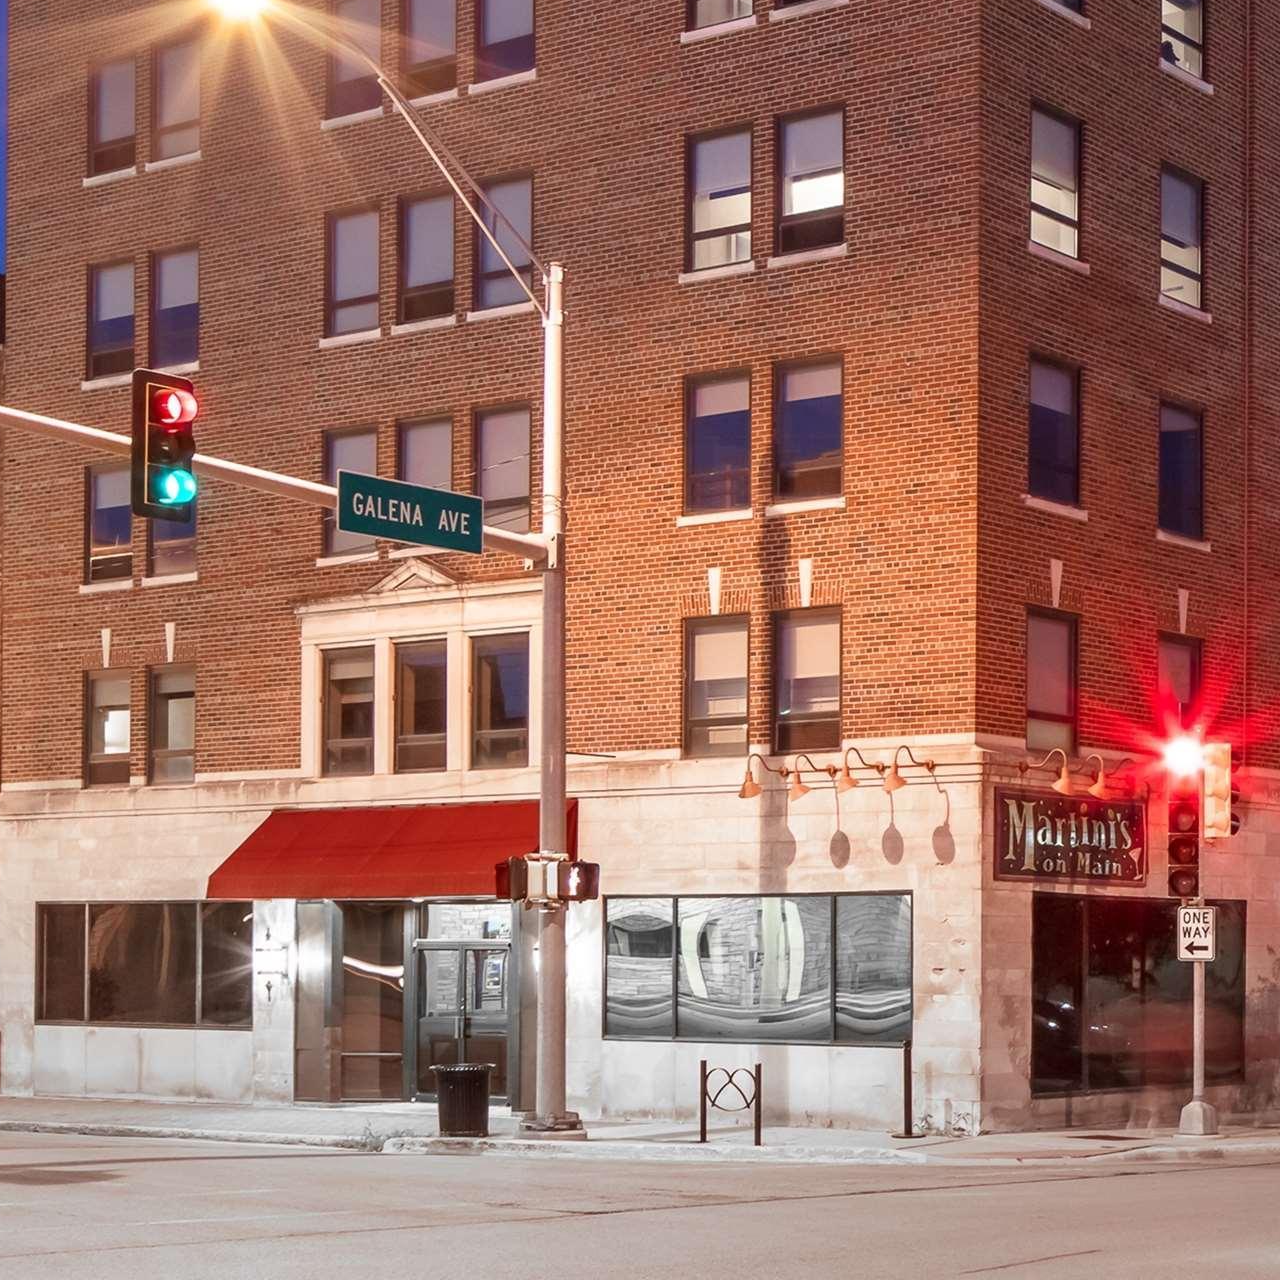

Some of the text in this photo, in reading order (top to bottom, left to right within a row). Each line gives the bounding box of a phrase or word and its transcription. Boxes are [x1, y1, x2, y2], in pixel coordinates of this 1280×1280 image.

[352, 492, 471, 535] GALENA AVE
[1003, 799, 1132, 872] Martini's
[1042, 851, 1122, 877] on Main
[1182, 911, 1210, 938] ONE WAY
